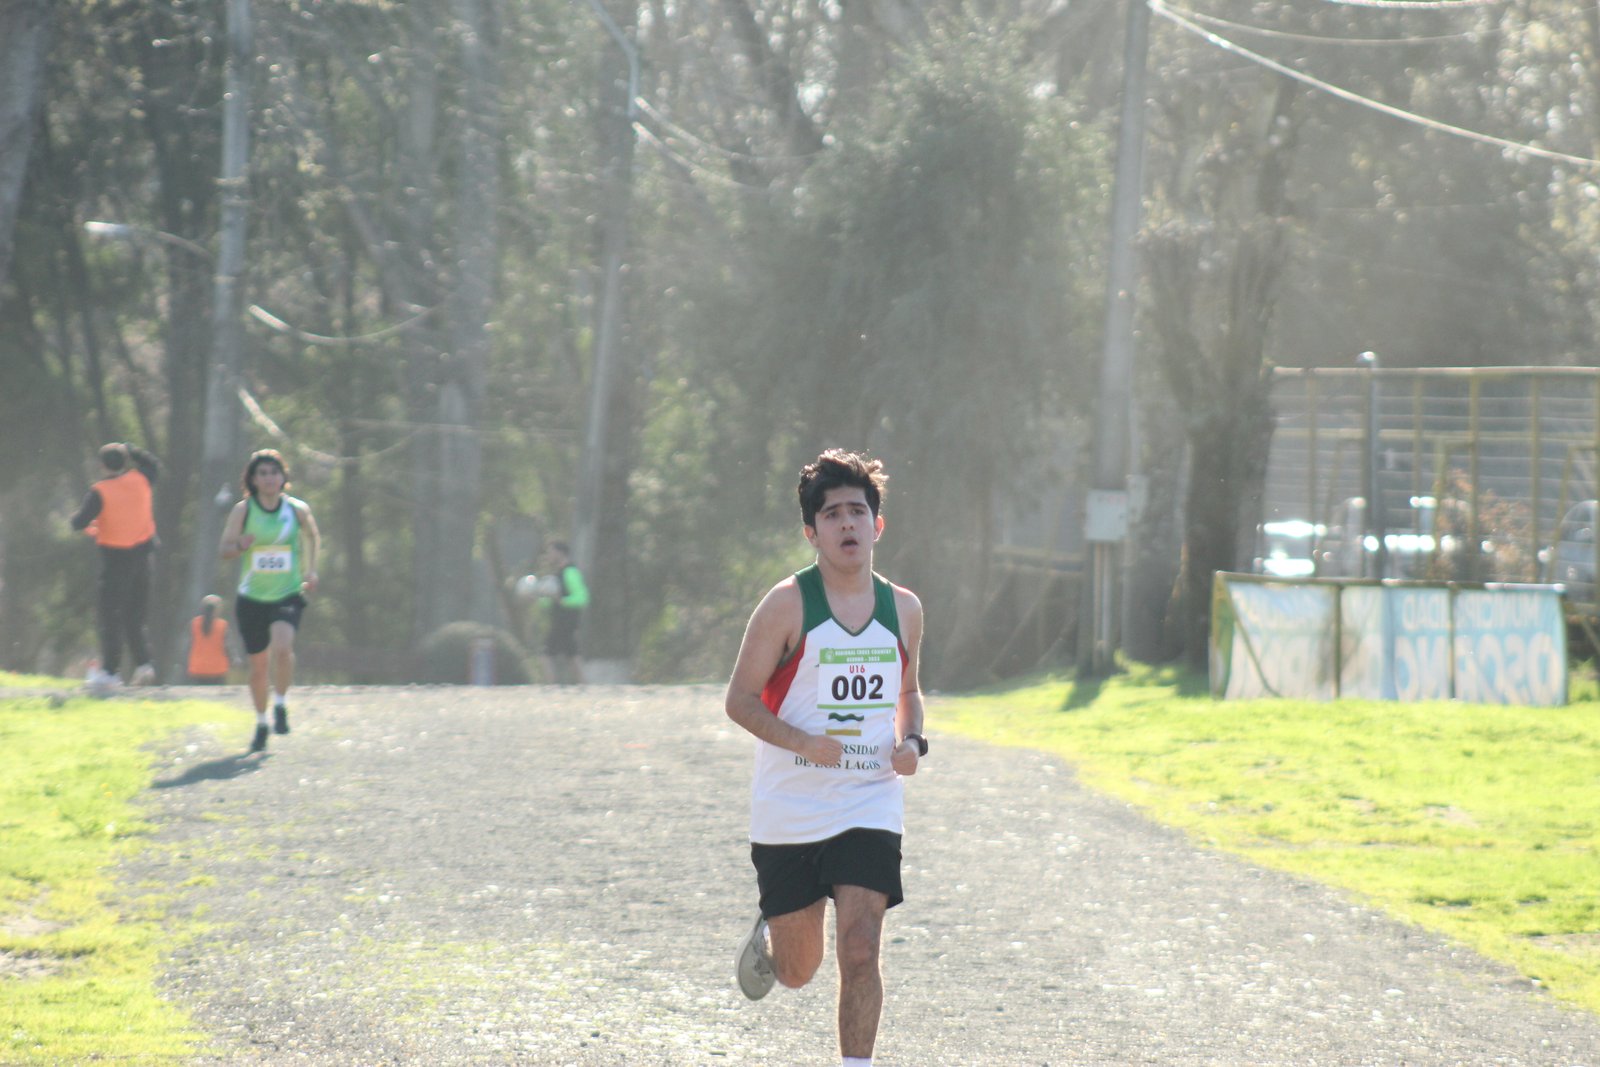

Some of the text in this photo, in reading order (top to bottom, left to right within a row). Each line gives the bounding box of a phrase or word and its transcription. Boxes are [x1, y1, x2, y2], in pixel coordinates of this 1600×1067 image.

[849, 665, 866, 673] U16
[831, 674, 884, 701] 002
[842, 744, 879, 755] RSIDAD
[795, 755, 811, 767] DE
[845, 759, 881, 770] LAGOS
